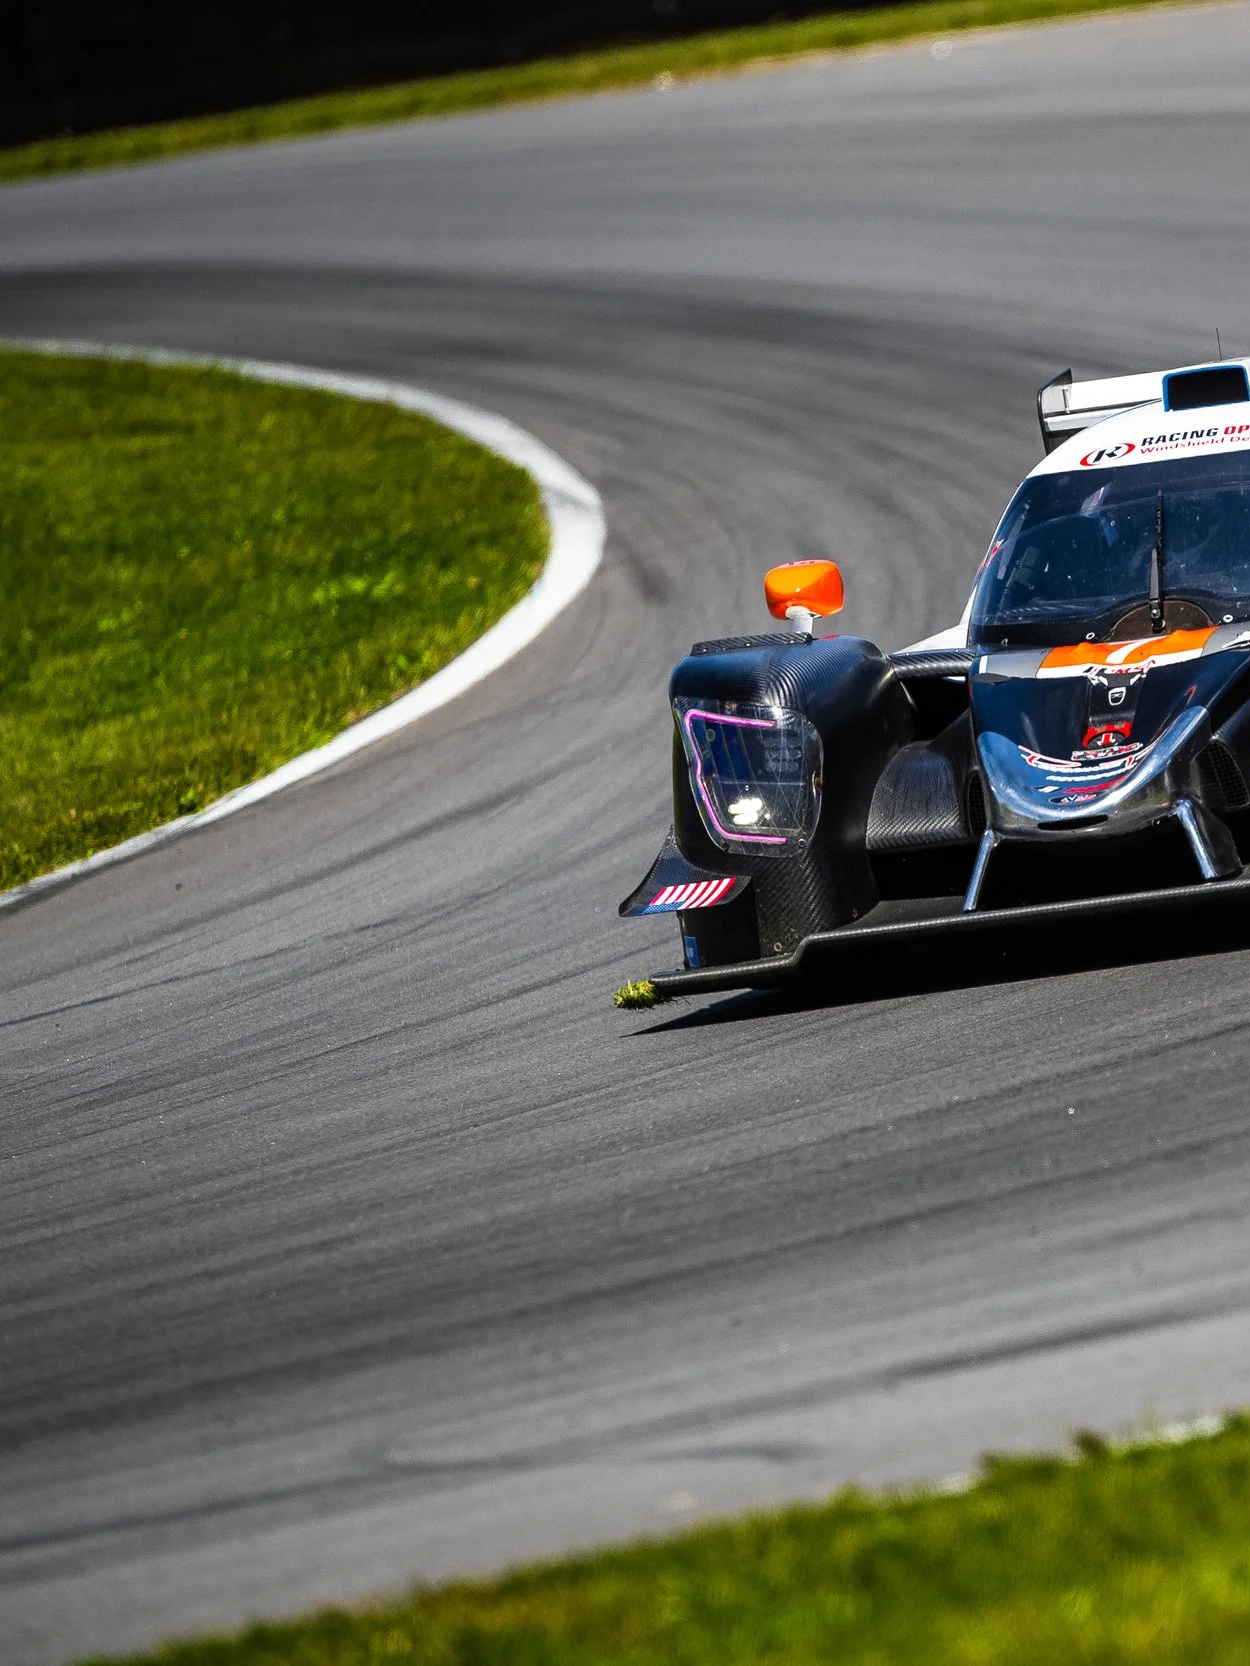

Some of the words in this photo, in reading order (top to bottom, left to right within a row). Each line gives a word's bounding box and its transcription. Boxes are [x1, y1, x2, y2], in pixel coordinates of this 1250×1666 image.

[1139, 436, 1225, 455] Windshield
[1141, 427, 1219, 447] RACING
[1105, 634, 1170, 664] 7
